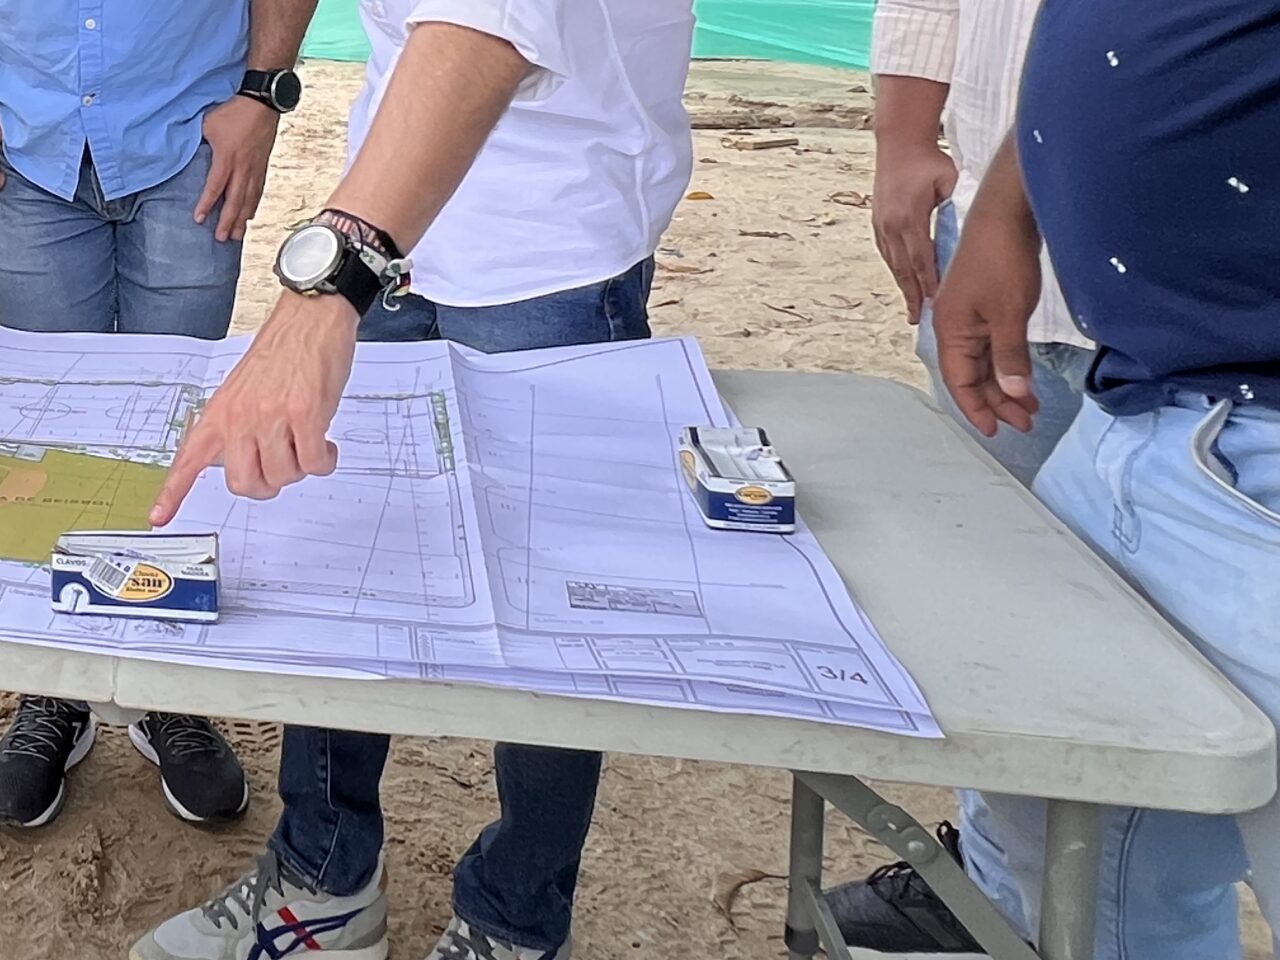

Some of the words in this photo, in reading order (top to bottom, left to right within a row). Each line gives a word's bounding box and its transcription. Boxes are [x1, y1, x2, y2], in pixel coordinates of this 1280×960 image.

[56, 557, 87, 567] CLAVOS
[129, 577, 162, 589] san
[816, 665, 868, 685] 3/4
